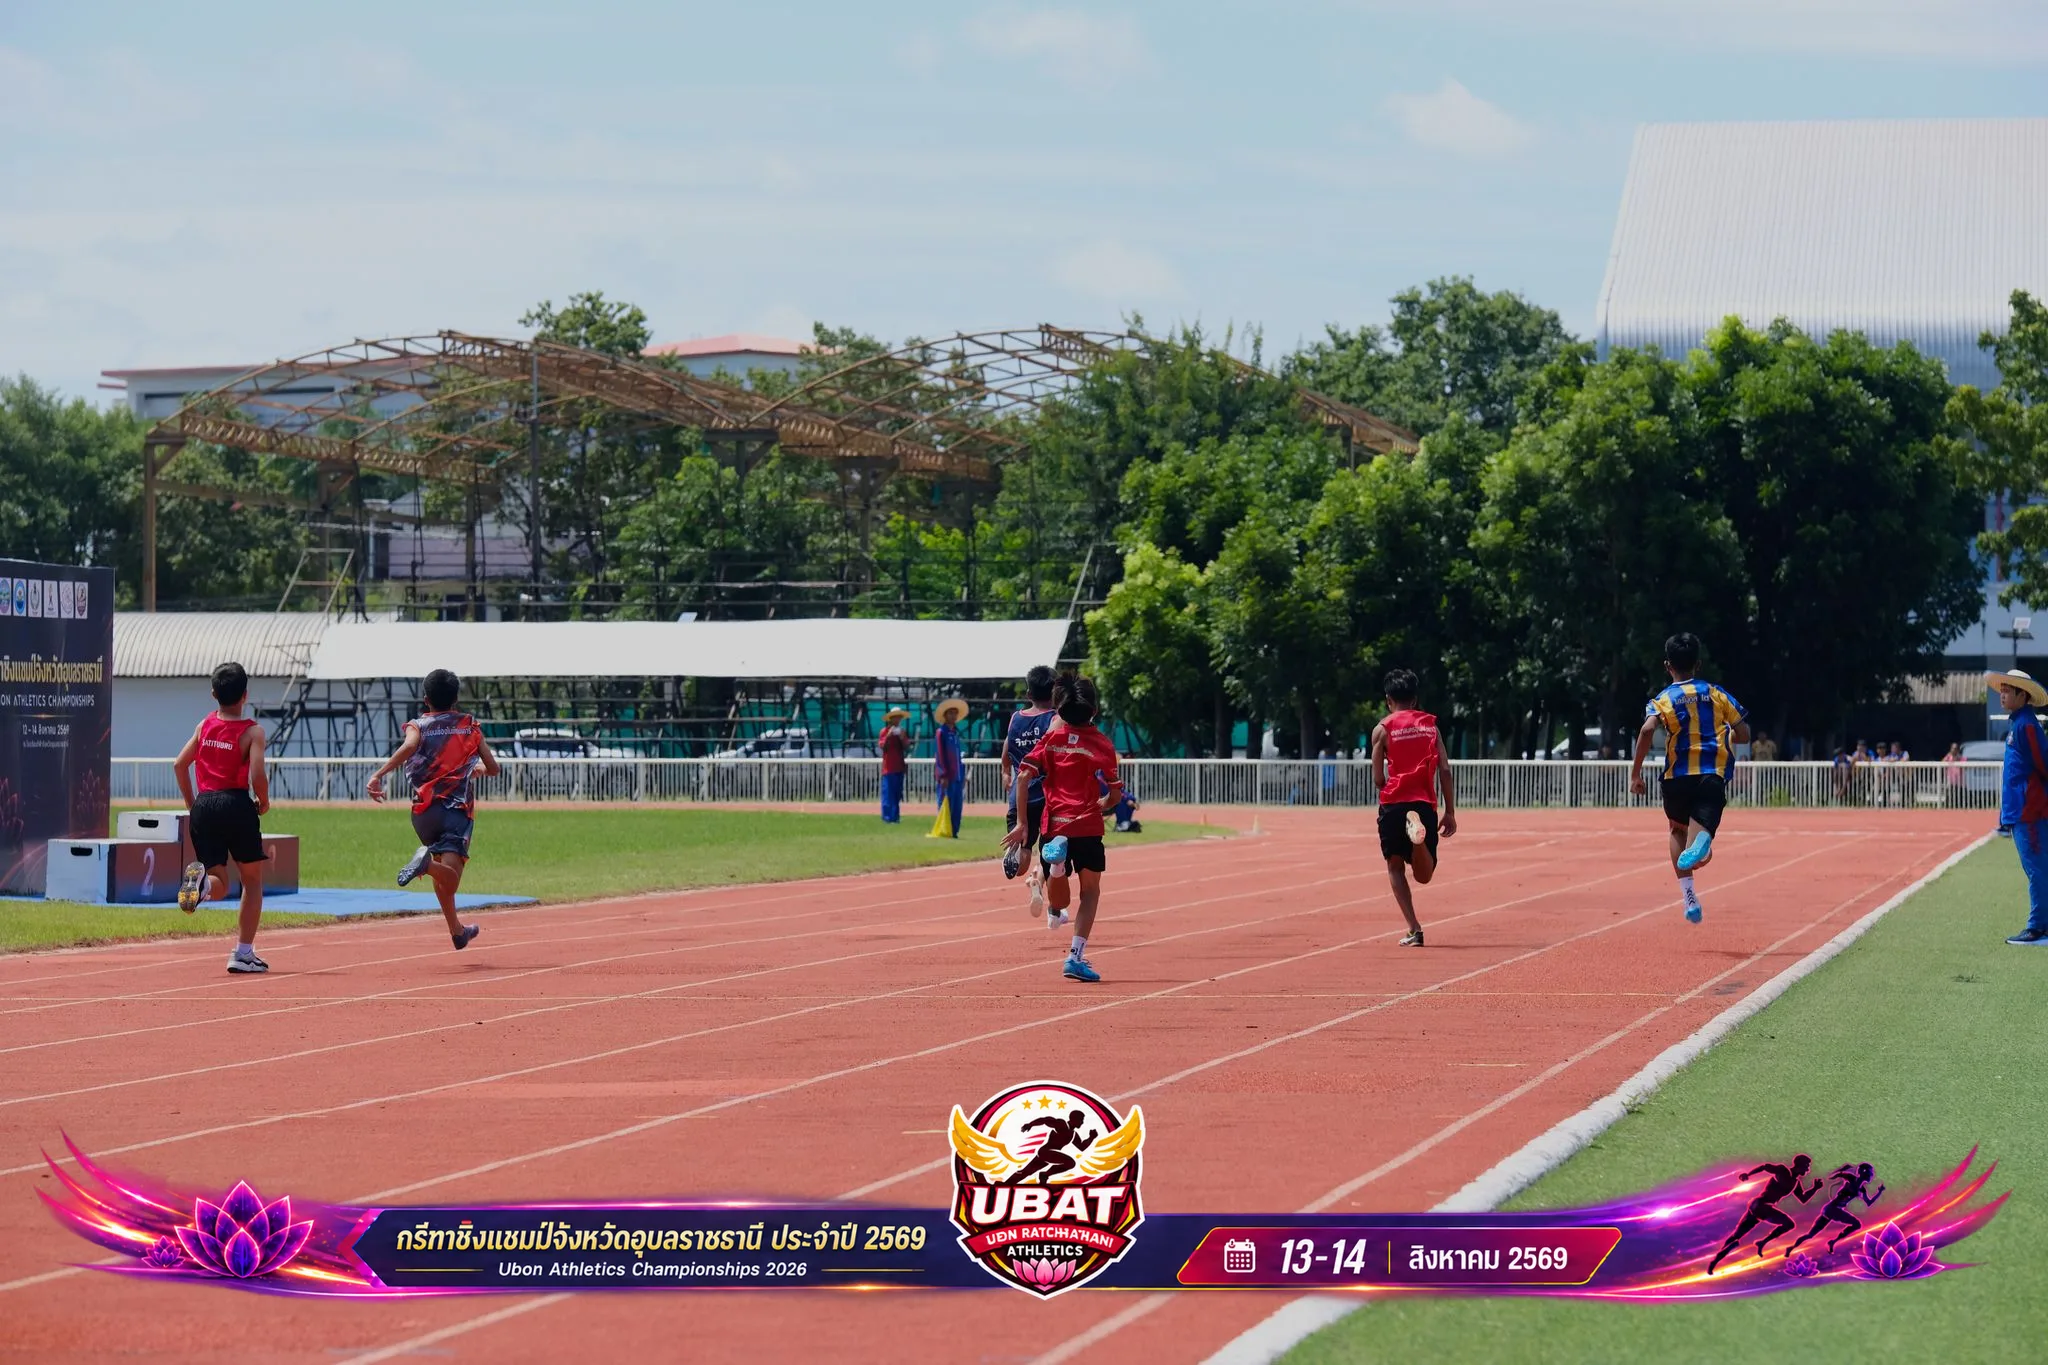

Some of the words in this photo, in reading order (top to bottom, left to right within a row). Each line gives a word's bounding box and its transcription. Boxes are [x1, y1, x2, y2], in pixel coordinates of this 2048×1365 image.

[0, 653, 103, 691] าชิงแชมป์จังหวัดอุบลราชธานี
[1, 694, 11, 706] ON
[13, 694, 46, 706] ATHLETICS
[48, 694, 95, 707] CHAMPIONSHIPS
